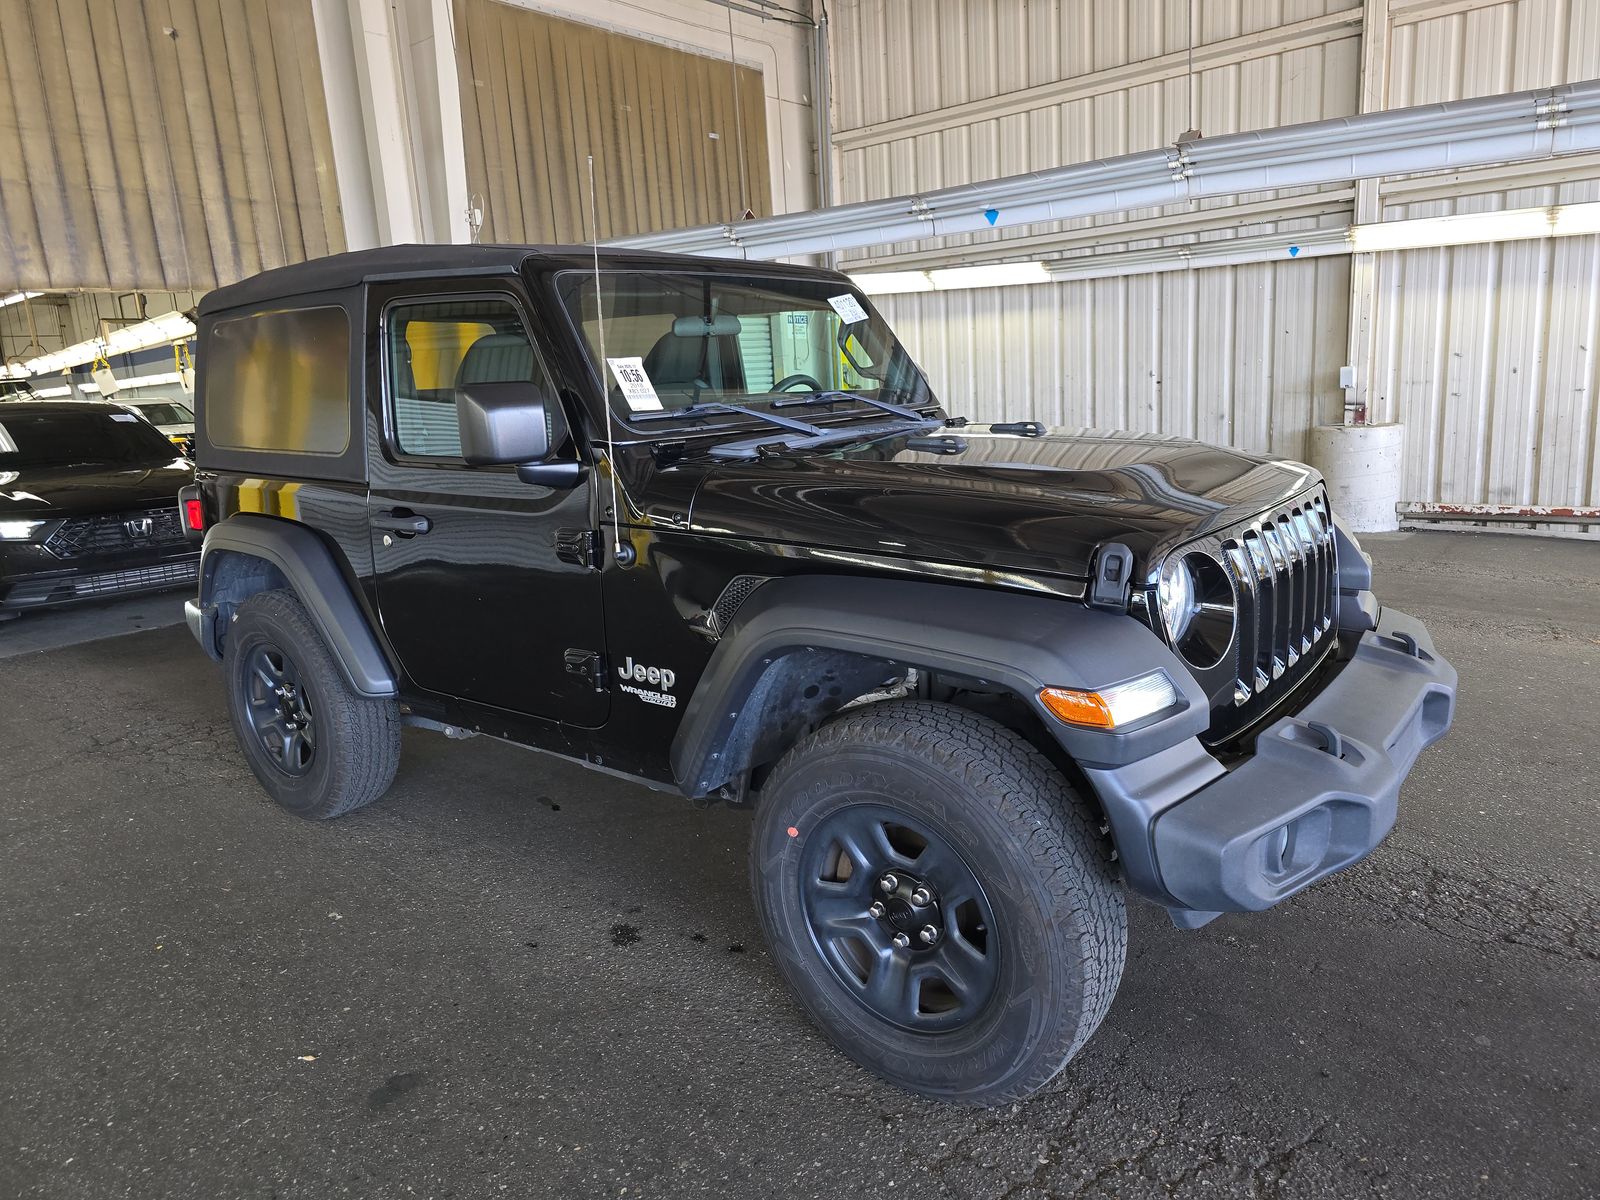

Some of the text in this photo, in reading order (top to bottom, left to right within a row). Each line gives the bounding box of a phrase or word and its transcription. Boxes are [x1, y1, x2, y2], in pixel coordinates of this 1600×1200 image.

[620, 369, 643, 382] 10:56
[618, 656, 675, 691] Jeep
[619, 683, 676, 701] WRANGLER
[641, 695, 676, 707] SPORT
